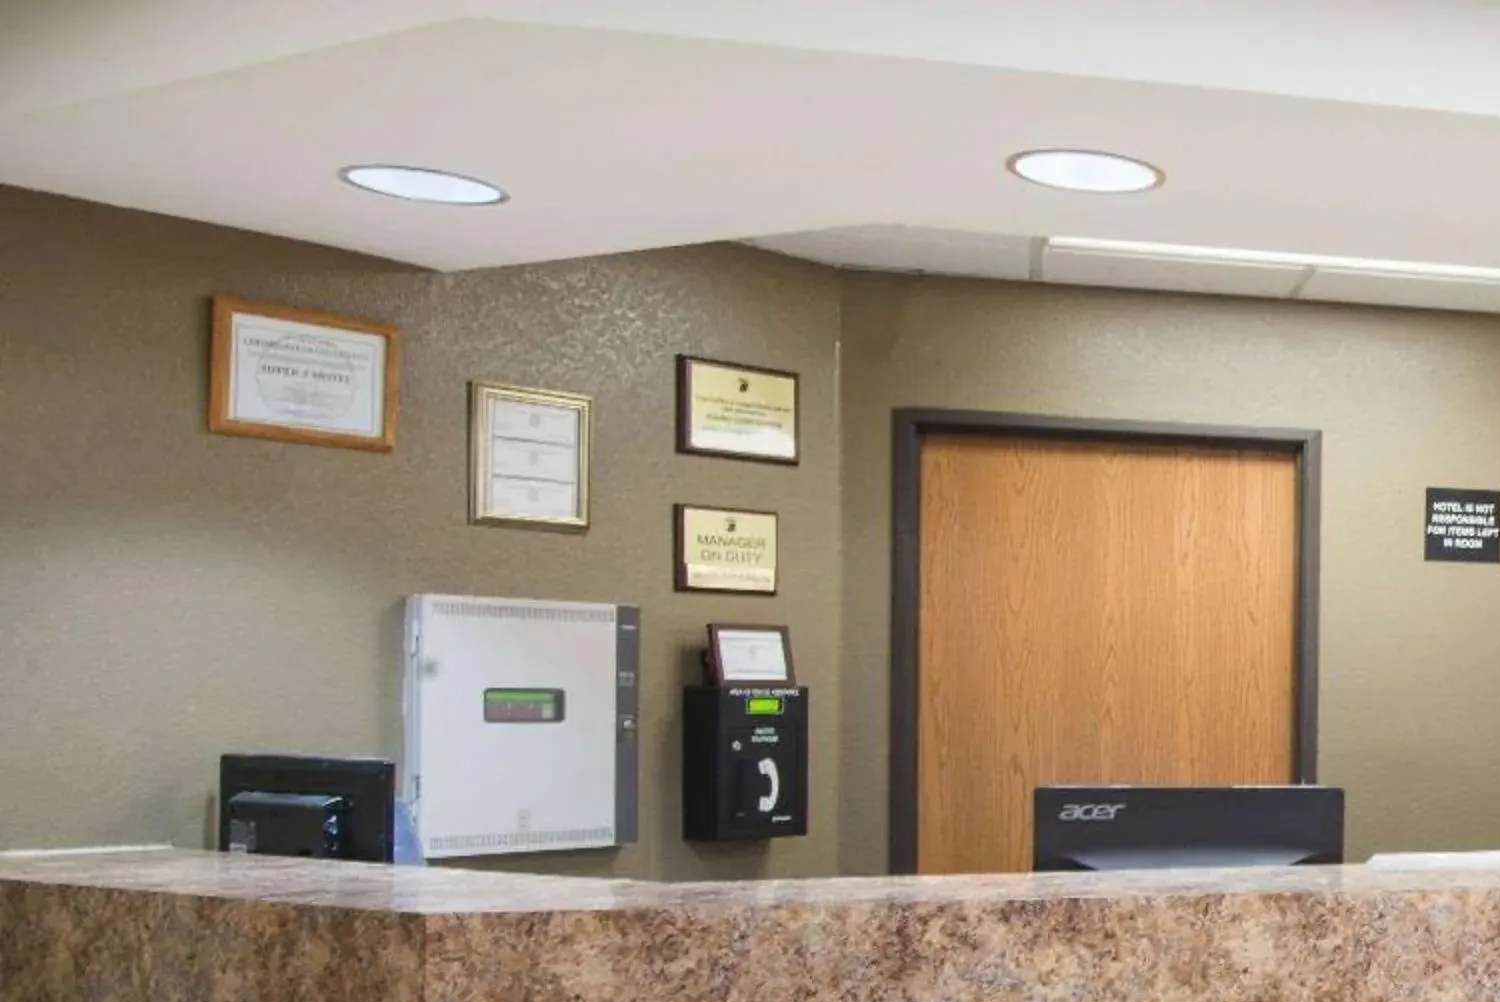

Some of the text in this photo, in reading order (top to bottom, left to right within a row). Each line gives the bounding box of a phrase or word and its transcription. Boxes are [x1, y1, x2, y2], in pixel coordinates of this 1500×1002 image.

[1433, 501, 1495, 514] HOTEL IS NOT
[1431, 513, 1495, 526] RESPONSIBLE
[1427, 524, 1500, 538] FOR ITEMS LEFT
[697, 533, 766, 551] MANAGER
[1443, 537, 1483, 549] IN ROOM
[701, 549, 763, 564] ON DUTY
[1059, 802, 1126, 821] acer
